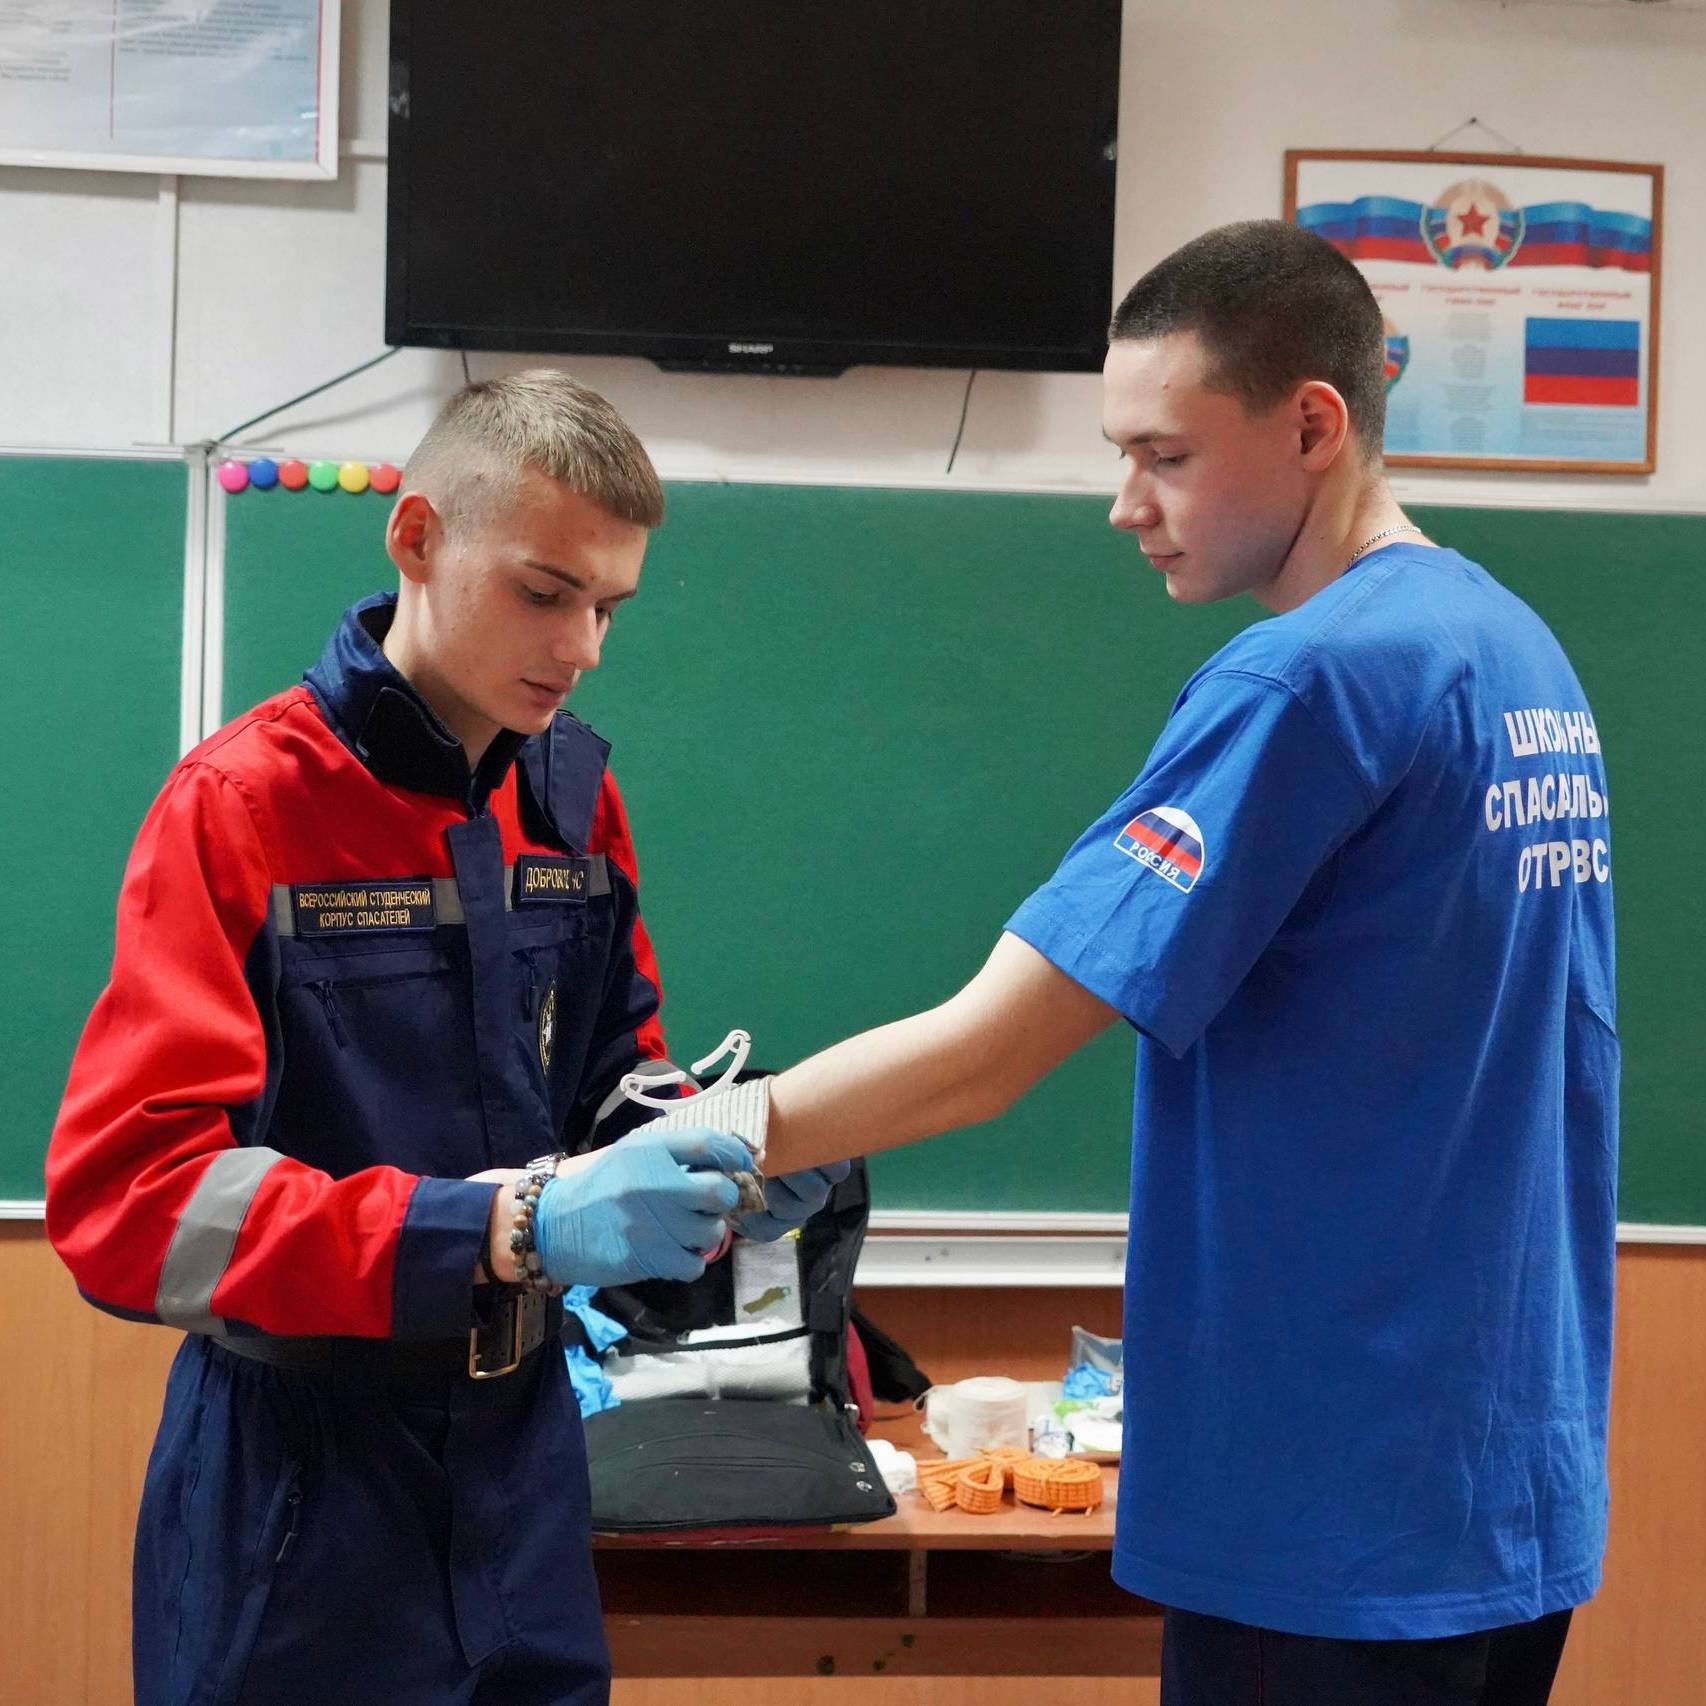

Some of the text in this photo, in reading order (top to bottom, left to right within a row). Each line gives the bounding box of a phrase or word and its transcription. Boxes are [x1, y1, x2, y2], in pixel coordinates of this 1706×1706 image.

[299, 888, 431, 909] ВСЕРОССИЙСКИЙ СТУДЕНЧЕСКИЙ
[319, 909, 411, 928] КОРПУС СПАСАТЕЛЕЙ
